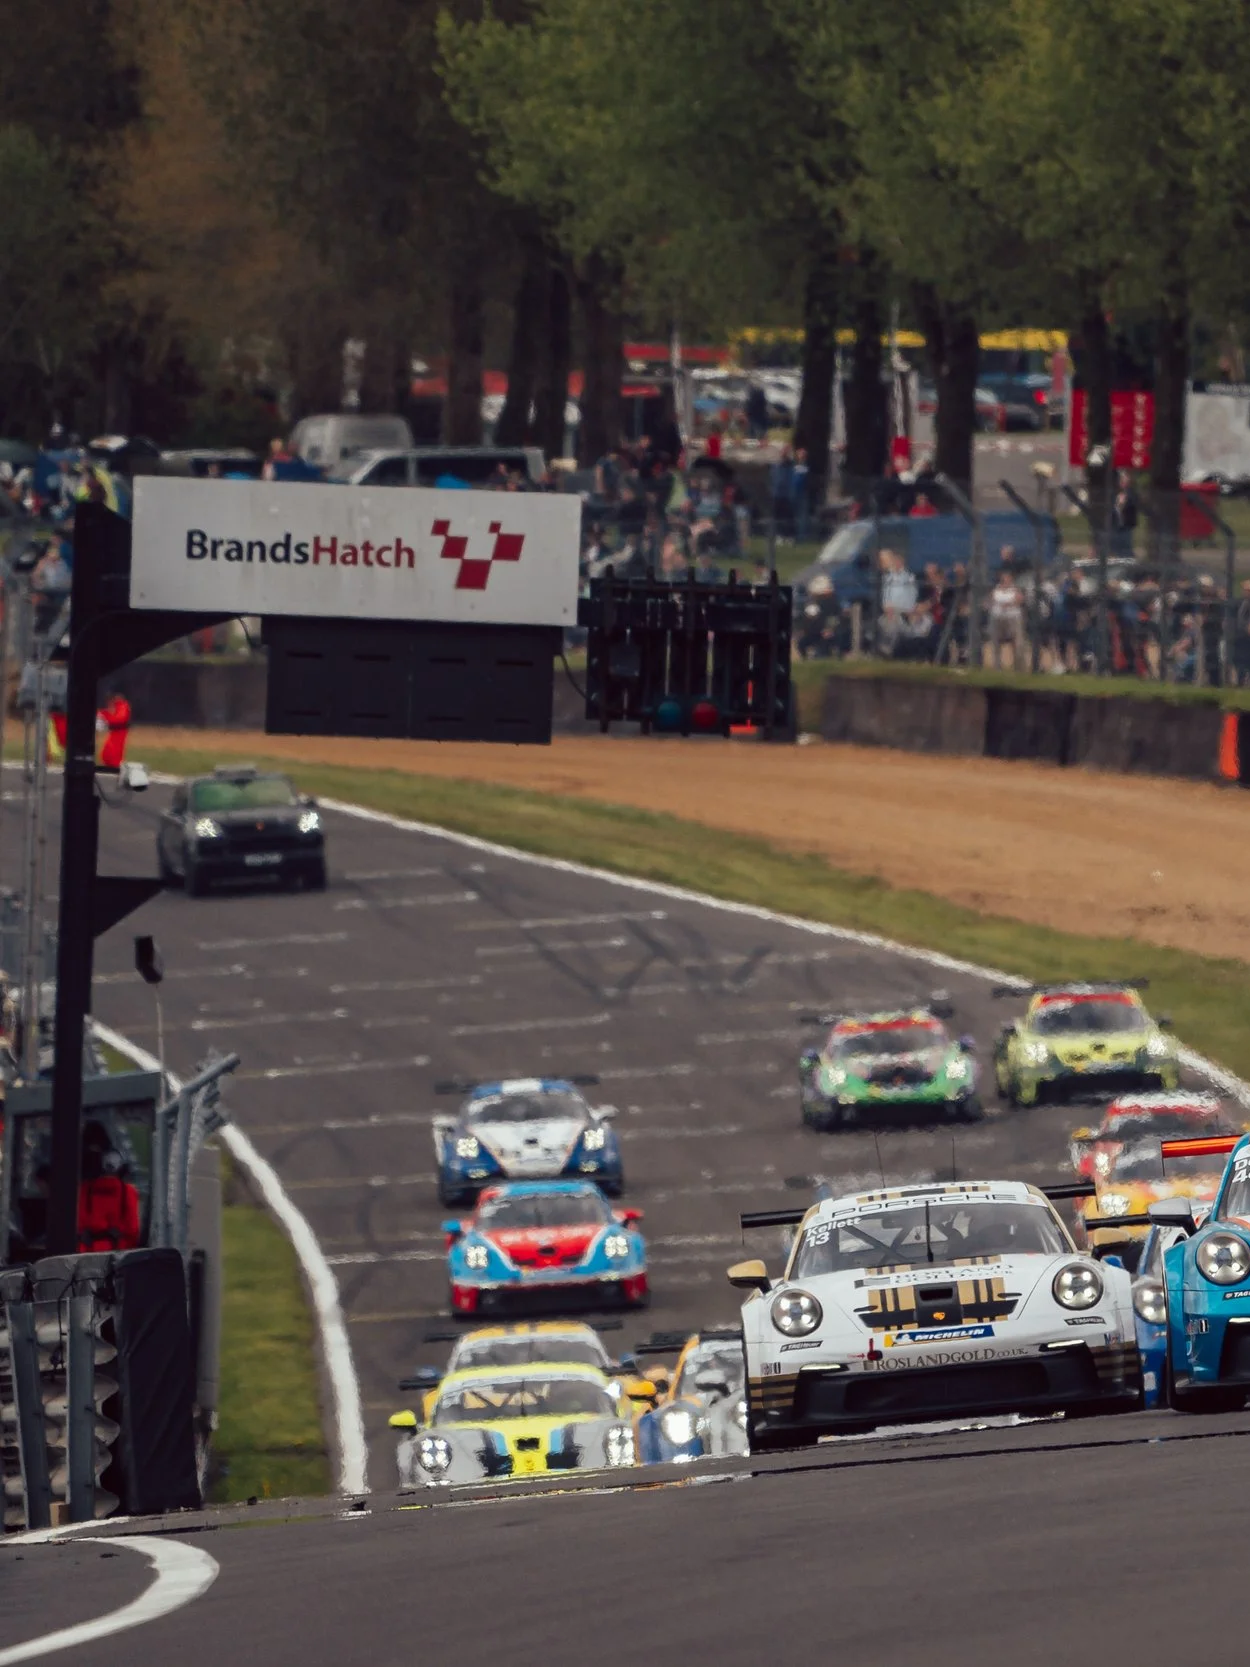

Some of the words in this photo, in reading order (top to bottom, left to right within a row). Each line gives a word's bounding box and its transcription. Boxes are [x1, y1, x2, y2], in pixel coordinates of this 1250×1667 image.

[185, 528, 416, 569] BrandsHatch
[832, 1193, 1017, 1218] PORSCHE
[806, 1217, 862, 1237] Kellett
[806, 1232, 830, 1248] 13
[914, 1328, 985, 1341] MICHELIN
